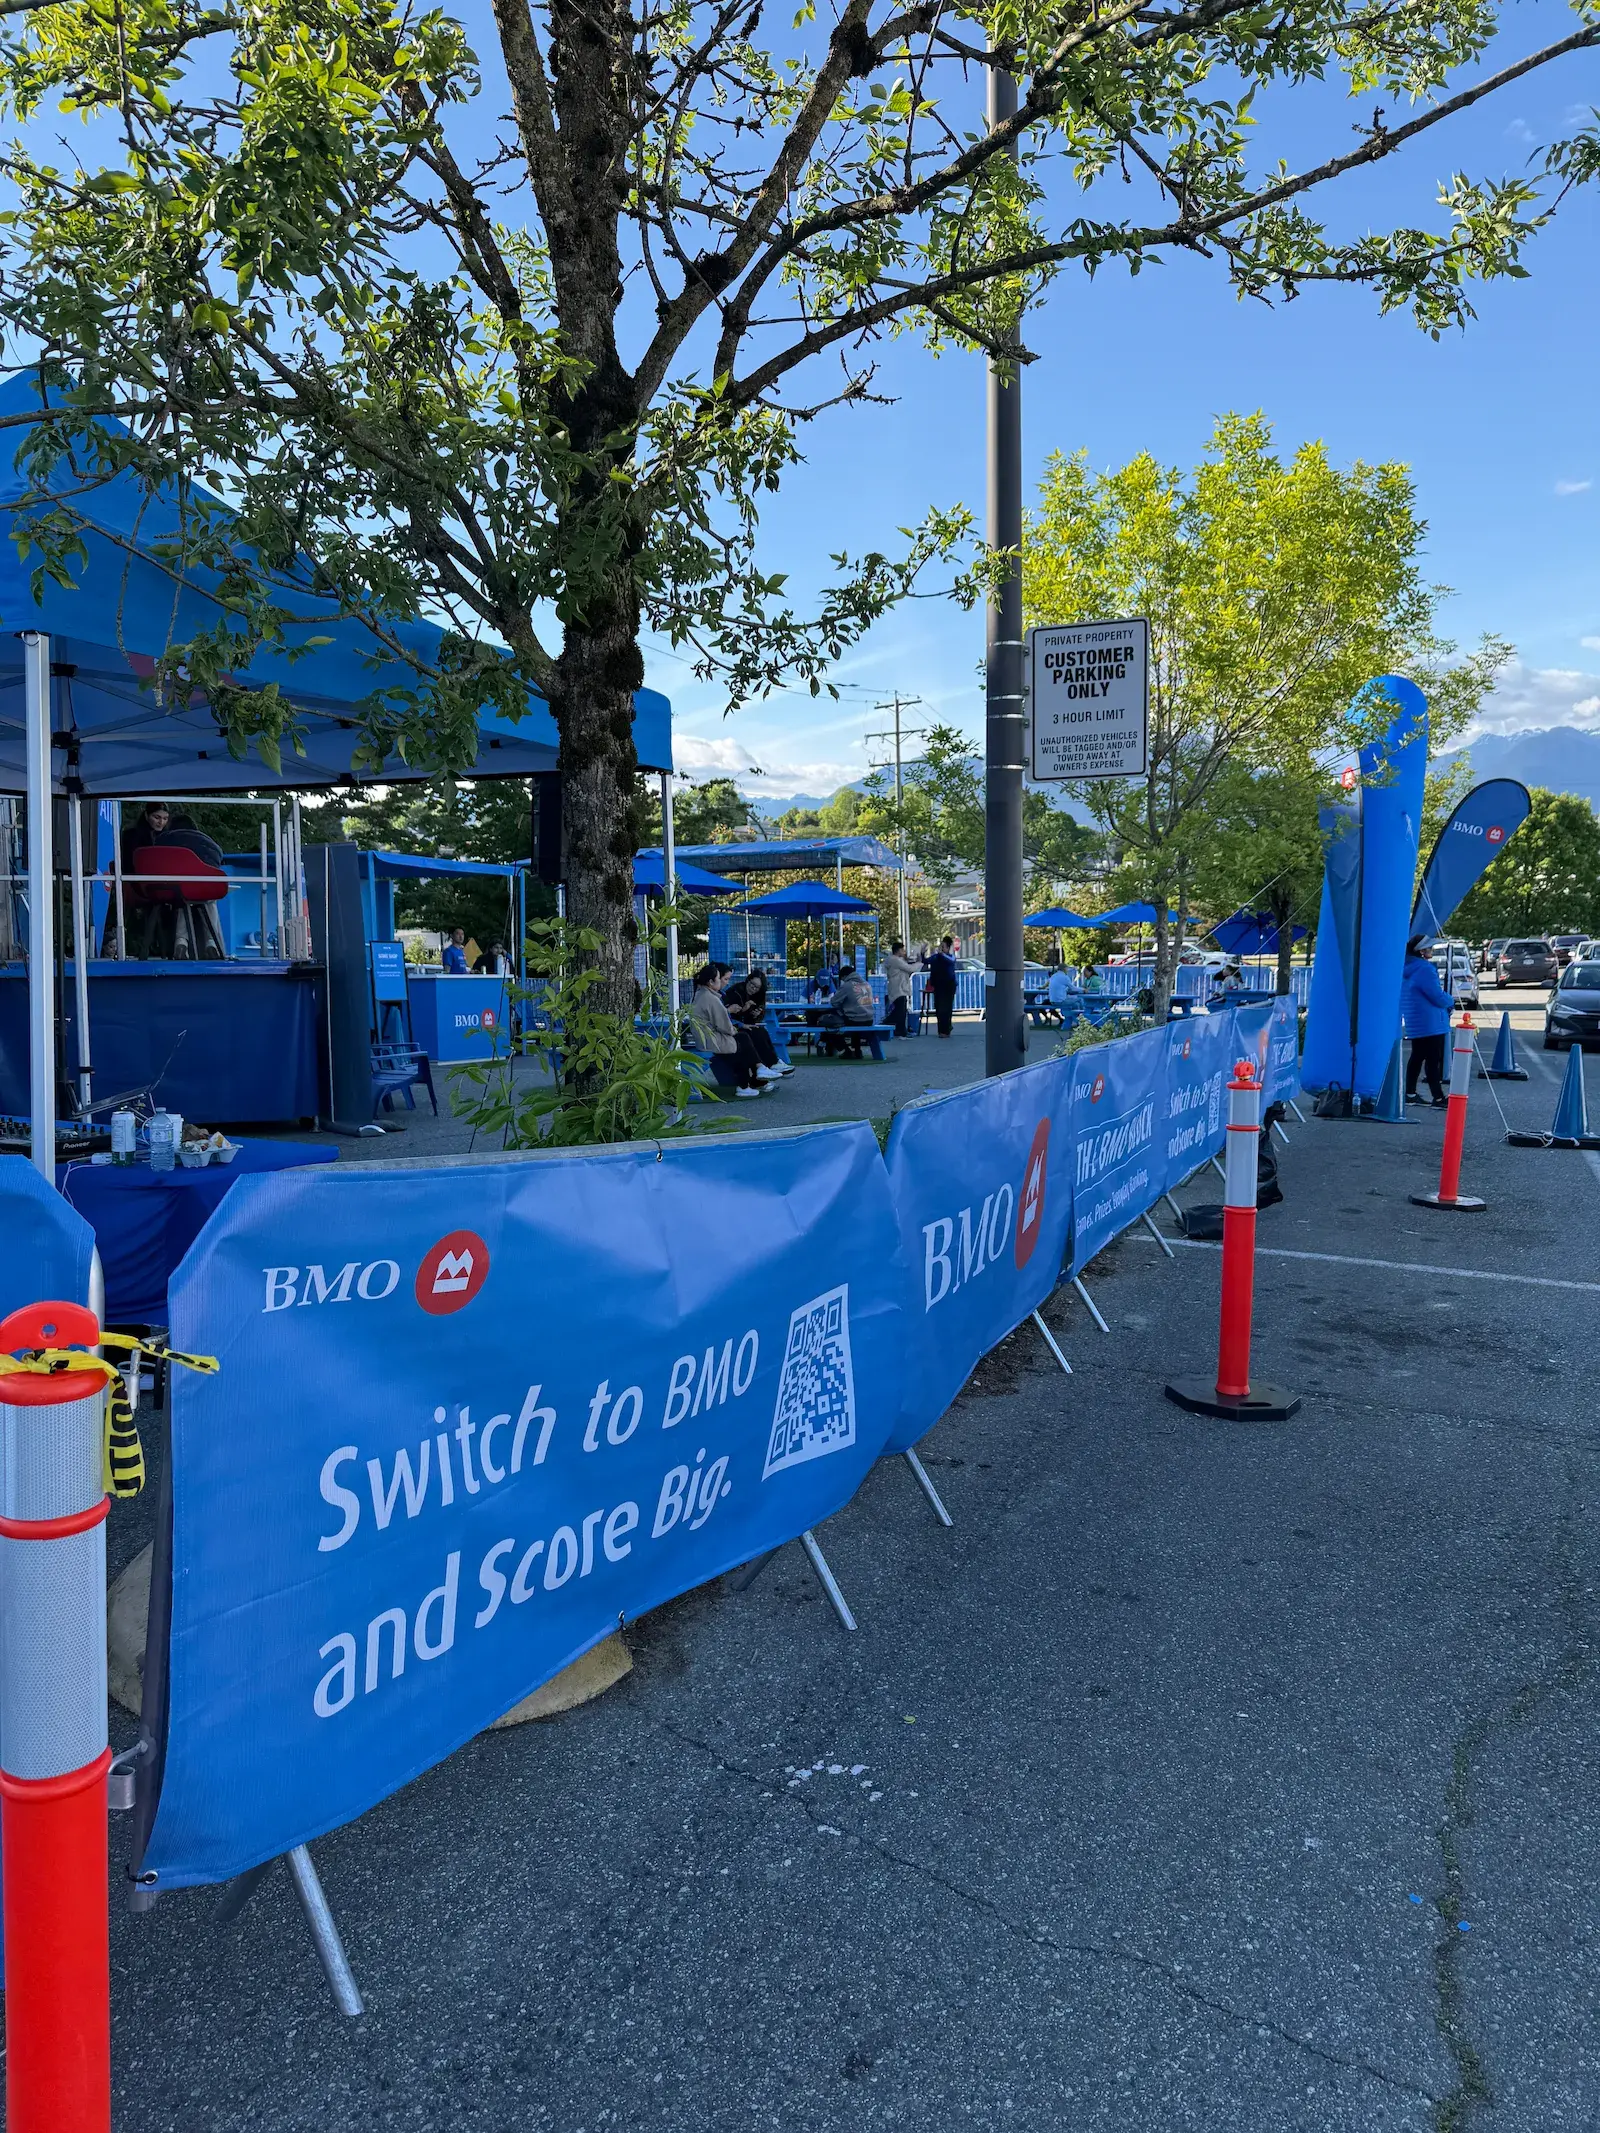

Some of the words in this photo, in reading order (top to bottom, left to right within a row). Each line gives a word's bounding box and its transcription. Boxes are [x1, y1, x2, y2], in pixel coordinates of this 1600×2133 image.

[1044, 635, 1083, 647] PRIVATE
[1085, 629, 1134, 643] PROPERTY
[1044, 646, 1135, 669] CUSTOMER
[1052, 663, 1126, 685] PARKING
[1067, 681, 1110, 699] ONLY
[1052, 714, 1059, 724] 3
[1062, 711, 1092, 723] HOUR
[1096, 709, 1125, 721] LIMIT
[1040, 733, 1099, 745] UNAUTHORIZED
[1100, 731, 1138, 741] VEHICLES
[1041, 745, 1061, 754] WILL
[1062, 744, 1072, 753] BE
[1074, 743, 1104, 752] TAGGED
[1106, 740, 1137, 750] AND/OR
[1057, 753, 1084, 762] TOWED
[1086, 752, 1109, 761] AWAY
[1110, 751, 1121, 759] AT
[1053, 762, 1088, 772] OWNER'S
[1089, 759, 1125, 769] EXPENSE
[1452, 820, 1484, 836] BMO
[454, 1014, 480, 1027] BMO
[62, 1140, 91, 1150] Pioneer
[922, 1182, 1014, 1314] BMO
[261, 1259, 401, 1313] BMO
[317, 1384, 557, 1552] Switch
[583, 1379, 644, 1453] to
[662, 1329, 760, 1429] BMO
[312, 1550, 461, 1718] and
[475, 1501, 639, 1629] Score
[651, 1447, 732, 1540] Big.
